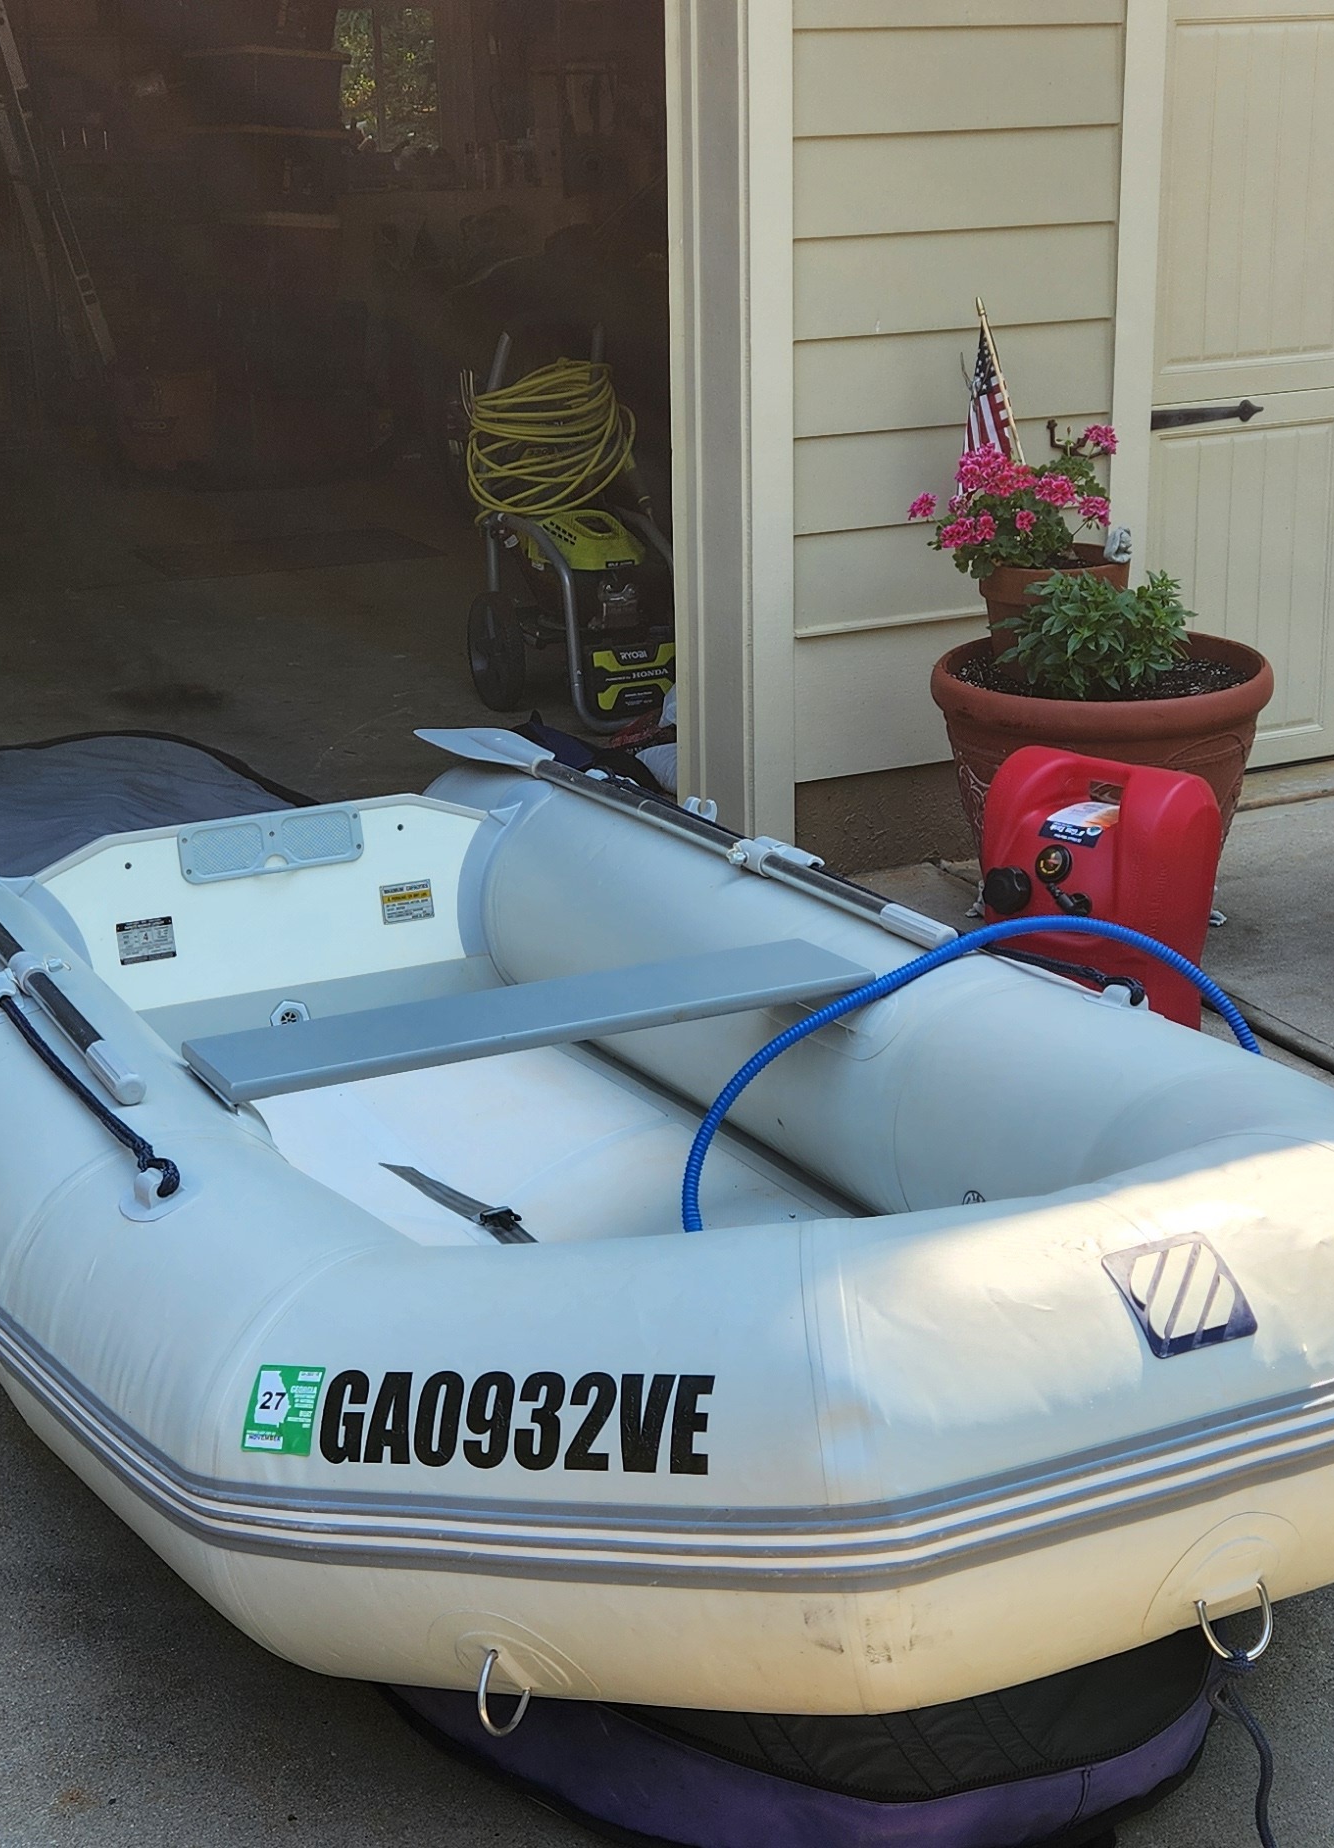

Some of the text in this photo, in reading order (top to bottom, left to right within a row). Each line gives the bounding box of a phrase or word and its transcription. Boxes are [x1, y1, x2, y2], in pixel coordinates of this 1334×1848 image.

[619, 649, 648, 660] RYOBI
[632, 667, 669, 679] HONDA
[258, 1390, 287, 1411] 27
[319, 1369, 716, 1475] GA0932VE
